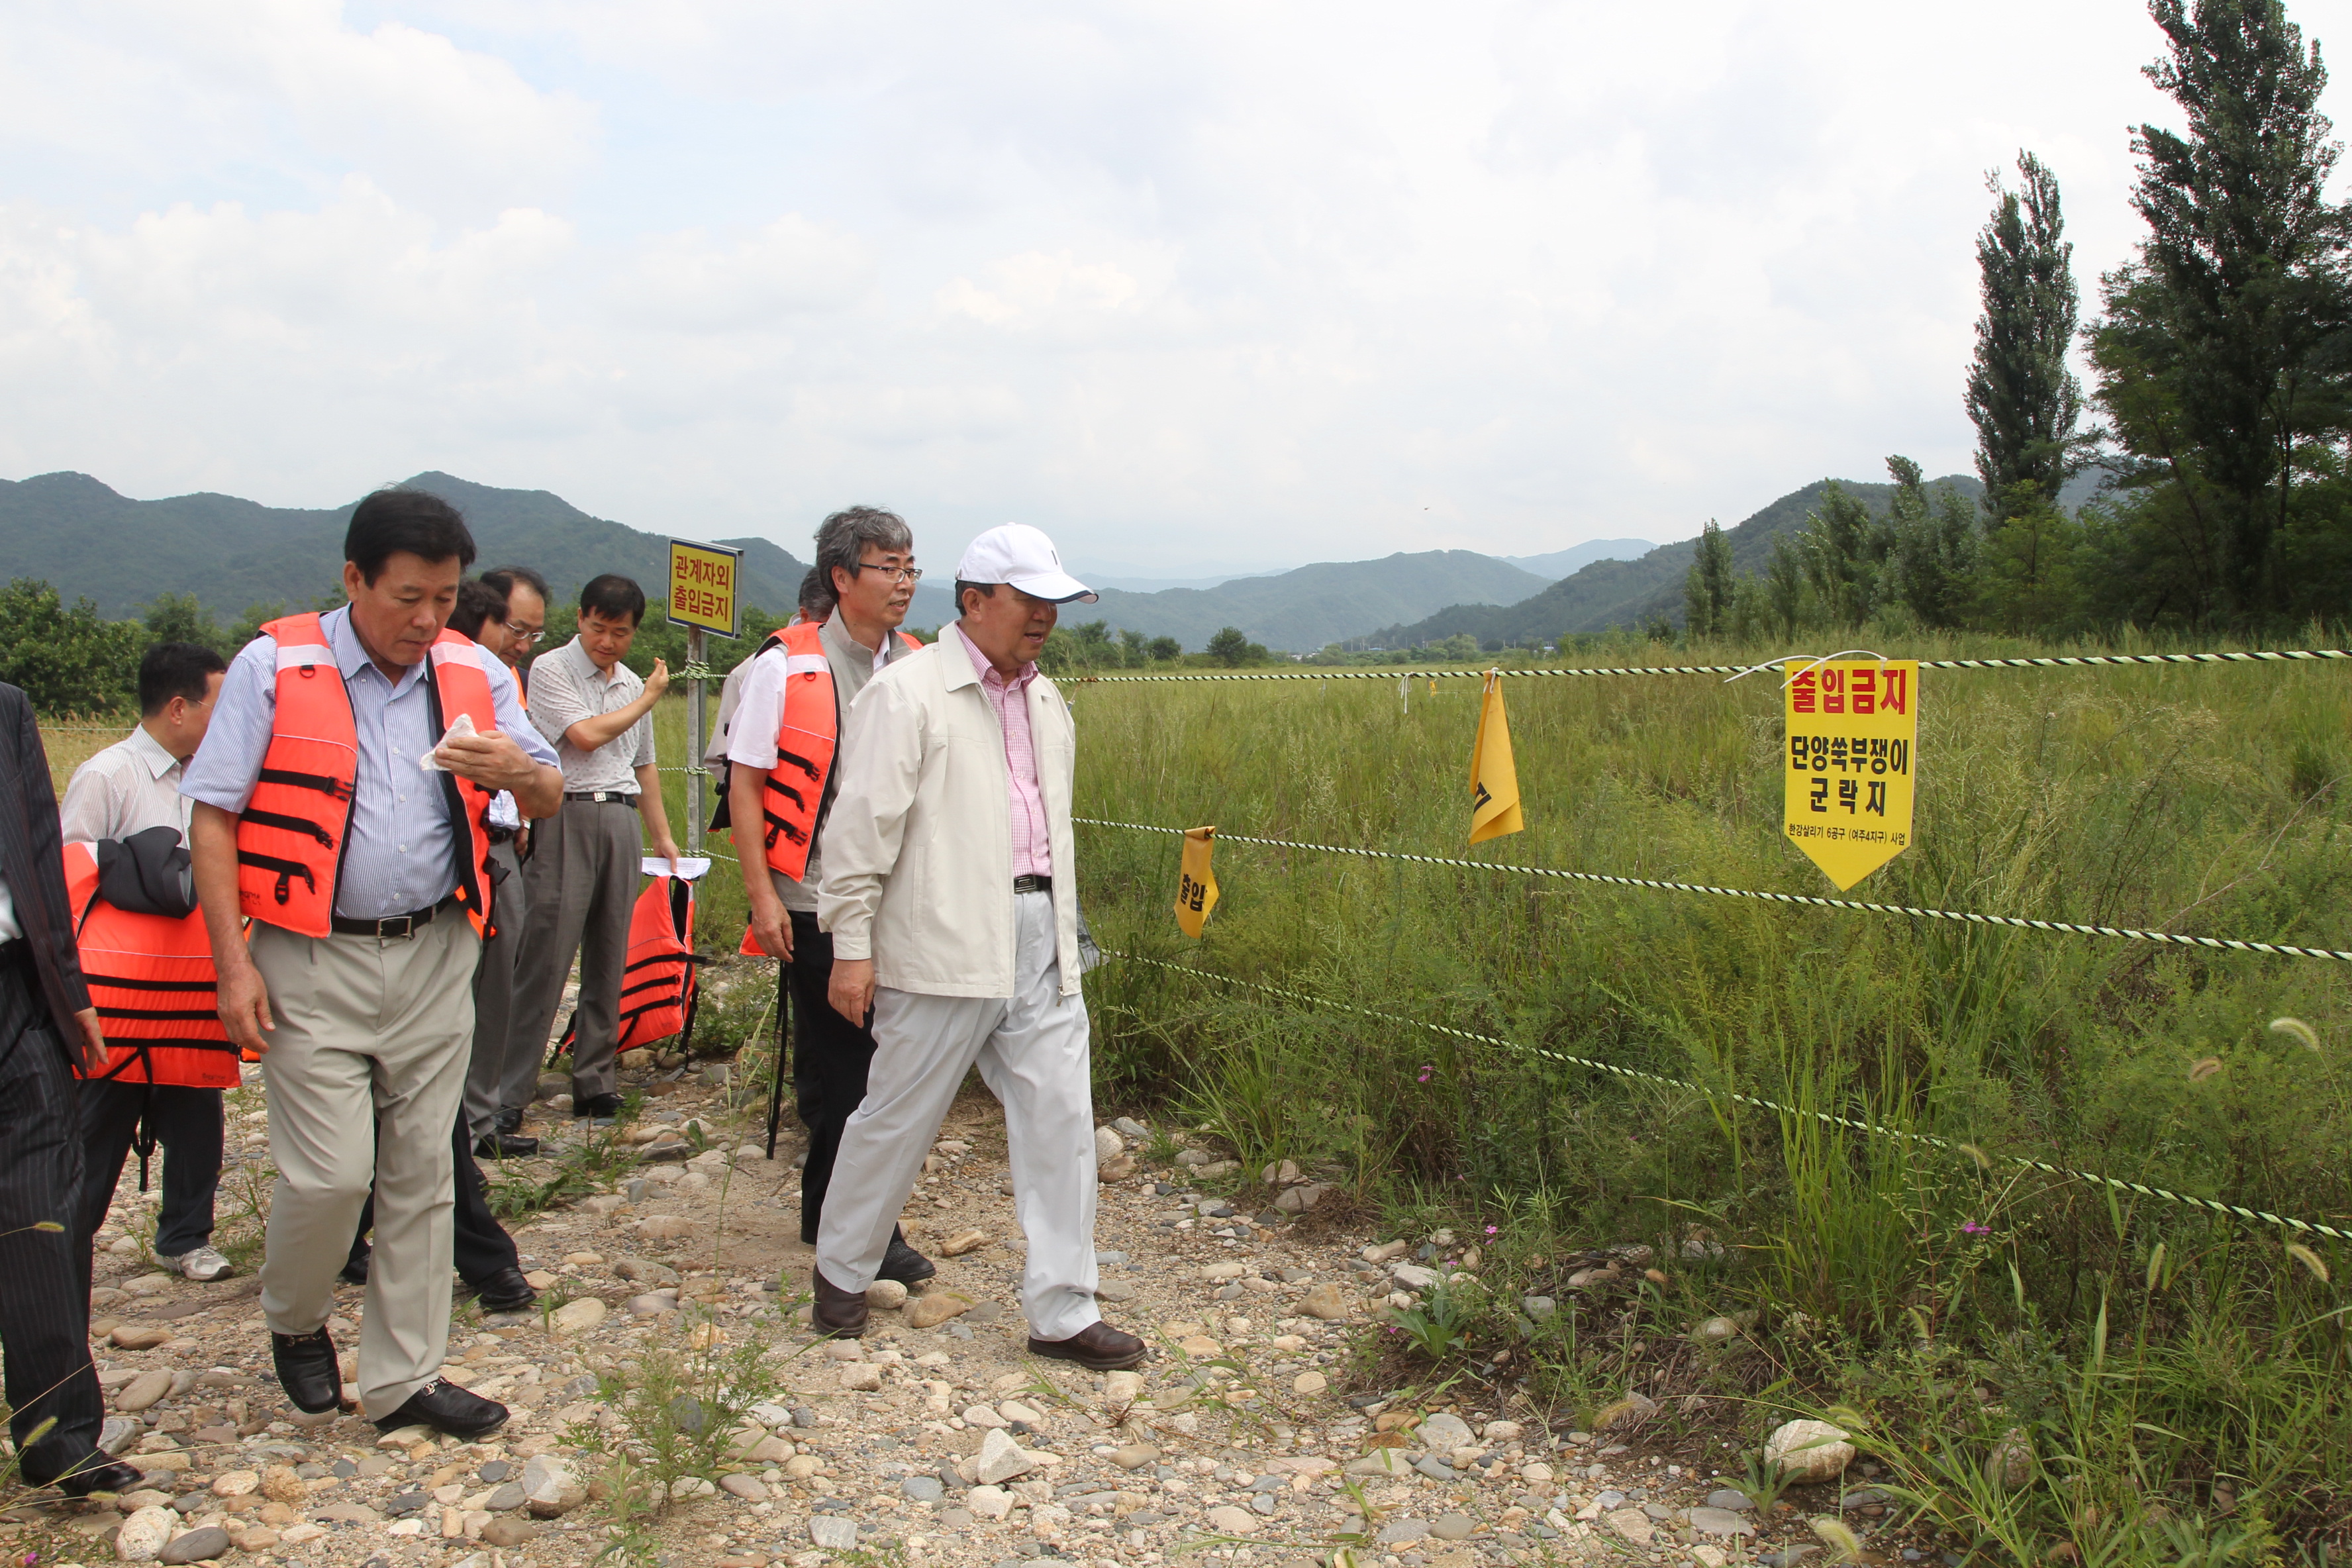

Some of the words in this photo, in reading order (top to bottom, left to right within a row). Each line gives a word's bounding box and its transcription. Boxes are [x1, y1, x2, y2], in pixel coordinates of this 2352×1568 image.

[675, 554, 730, 591] 관계자외
[674, 585, 729, 622] 출입금지
[1792, 669, 1906, 714] 출입금지
[1791, 736, 1908, 775] 단양쑥부쟁이
[1788, 823, 1824, 838] 한강살리기
[1827, 827, 1845, 840] 6공구
[1849, 828, 1887, 844] (여주4지구)
[1890, 832, 1905, 846] 사업
